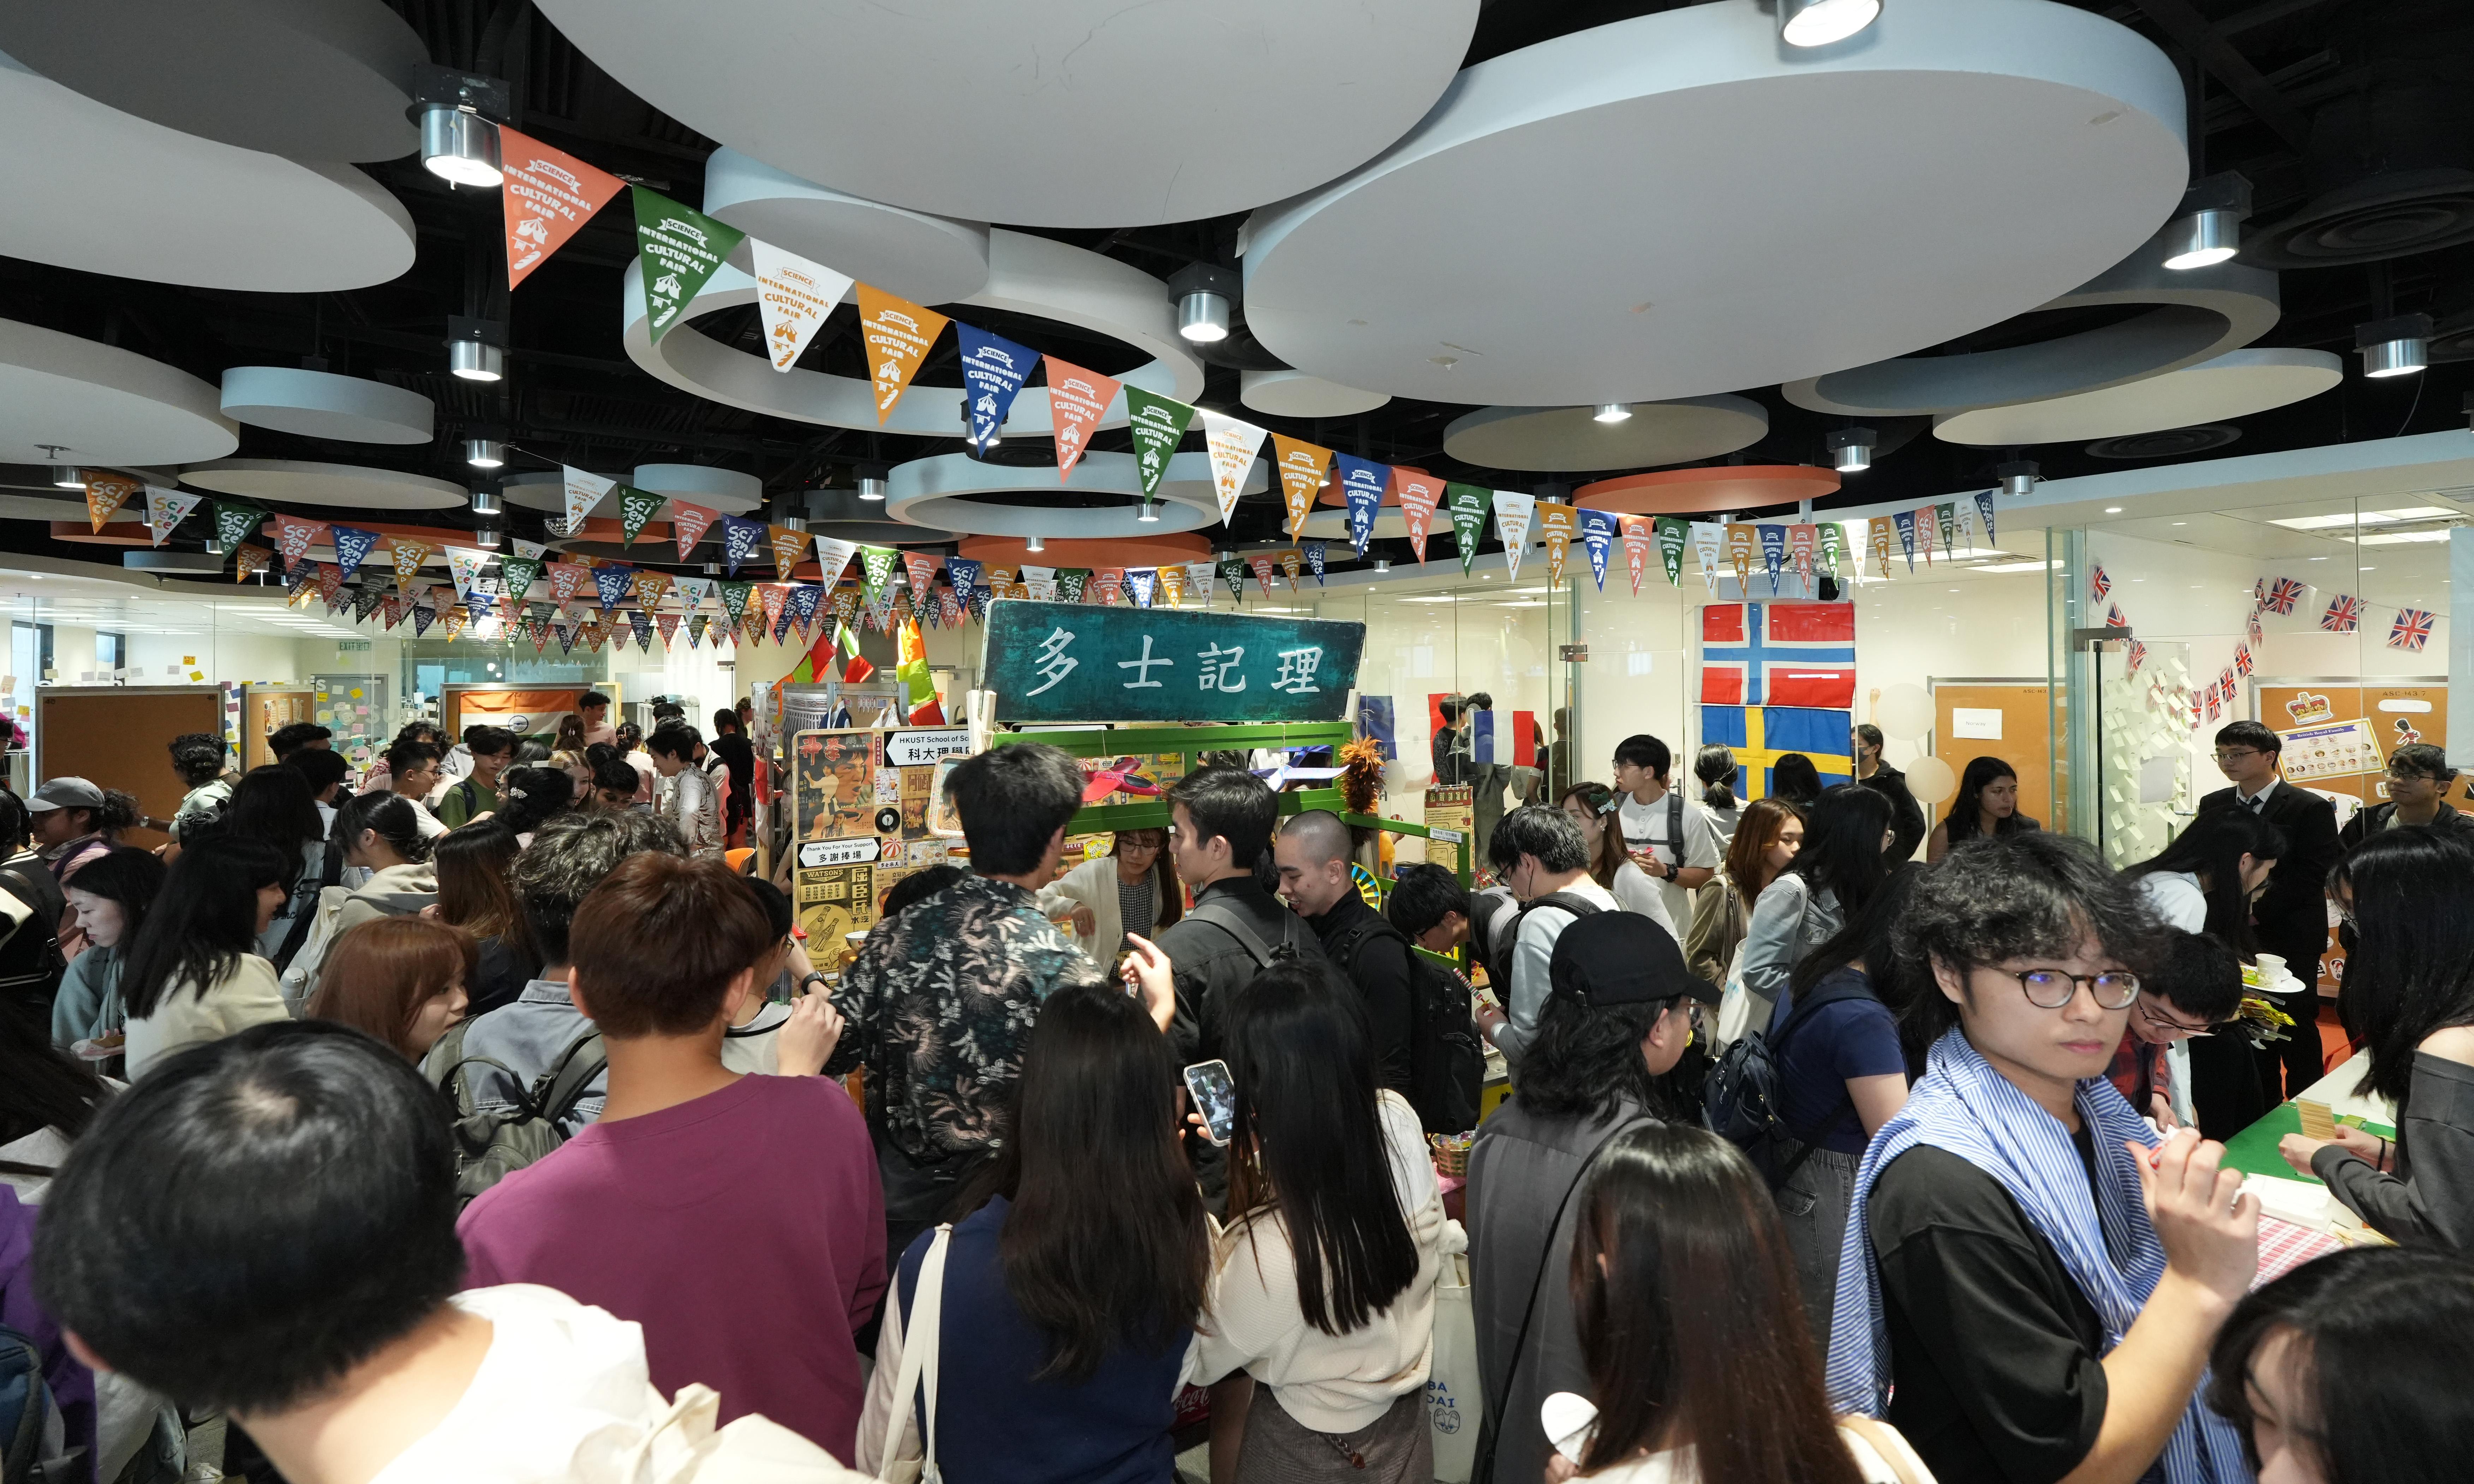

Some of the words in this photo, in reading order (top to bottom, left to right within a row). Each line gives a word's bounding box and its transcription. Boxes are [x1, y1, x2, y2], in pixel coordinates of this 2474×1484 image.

[536, 163, 573, 183] SCIENCE
[503, 164, 591, 211] INTERNATIONAL
[510, 185, 575, 221] CULTURAL
[525, 200, 555, 221] FAIR
[667, 221, 701, 239] SCIENCE
[639, 225, 718, 263] INTERNATIONAL
[646, 244, 705, 274] CULTURAL
[659, 258, 687, 274] FAIR
[783, 269, 813, 286] SCIENCE
[758, 276, 829, 308] INTERNATIONAL
[765, 293, 817, 319] CULTURAL
[778, 306, 801, 320] FAIR
[885, 312, 912, 325] SCIENCE
[863, 319, 928, 346] INTERNATIONAL
[870, 335, 918, 358] CULTURAL
[882, 347, 904, 359] FAIR
[983, 349, 1008, 361] SCIENCE
[963, 356, 1022, 381] INTERNATIONAL
[968, 371, 1012, 392] CULTURAL
[979, 381, 999, 393] FAIR
[1069, 381, 1090, 392] SCIENCE
[1050, 387, 1103, 410] INTERNATIONAL
[1055, 402, 1094, 421] CULTURAL
[1064, 413, 1082, 423] FAIR
[1147, 408, 1167, 418] SCIENCE
[1131, 415, 1179, 435] INTERNATIONAL
[1135, 428, 1172, 445] CULTURAL
[1224, 431, 1242, 440] SCIENCE
[1145, 438, 1161, 448] FAIR
[1209, 440, 1253, 455] INTERNATIONAL
[1214, 452, 1247, 467] CULTURAL
[1280, 462, 1321, 476] INTERNATIONAL
[1284, 472, 1315, 486] CULTURAL
[91, 481, 124, 499] Sci
[1343, 480, 1382, 492] INTERNATIONAL
[96, 495, 118, 508] en
[1348, 489, 1377, 502] CULTURAL
[1399, 493, 1434, 506] INTERNATIONAL
[92, 504, 111, 515] ce
[154, 497, 184, 514] Sci
[624, 497, 651, 513] Sci
[1404, 503, 1429, 516] CULTURAL
[158, 510, 178, 522] en
[221, 511, 249, 528] Sci
[629, 511, 646, 523] en
[1455, 514, 1480, 524] CULTURAL
[154, 519, 172, 530] ce
[225, 524, 244, 536] en
[625, 521, 640, 531] ce
[1502, 521, 1524, 529] CULTURAL
[221, 533, 239, 543] ce
[284, 525, 312, 540] Sci
[1547, 531, 1568, 539] CULTURAL
[288, 537, 307, 549] en
[339, 536, 366, 550] Sci
[1586, 535, 1608, 545] CULTURAL
[285, 546, 302, 556] ce
[344, 548, 361, 559] en
[341, 557, 357, 566] ce
[454, 556, 478, 569] Sci
[868, 555, 890, 569] Sci
[458, 567, 474, 577] en
[508, 564, 531, 577] Sci
[874, 567, 887, 578] en
[952, 567, 972, 579] Sci
[456, 576, 470, 584] ce
[512, 576, 528, 585] en
[871, 577, 883, 586] ce
[957, 579, 970, 588] en
[510, 584, 524, 593] ce
[956, 587, 968, 596] ce
[357, 642, 369, 650] 出口
[846, 734, 872, 744] 成龍
[799, 736, 846, 765] 神拳
[819, 851, 861, 863] 多謝捧場
[806, 868, 844, 878] WATSON'S
[851, 867, 867, 915] 屈臣氏
